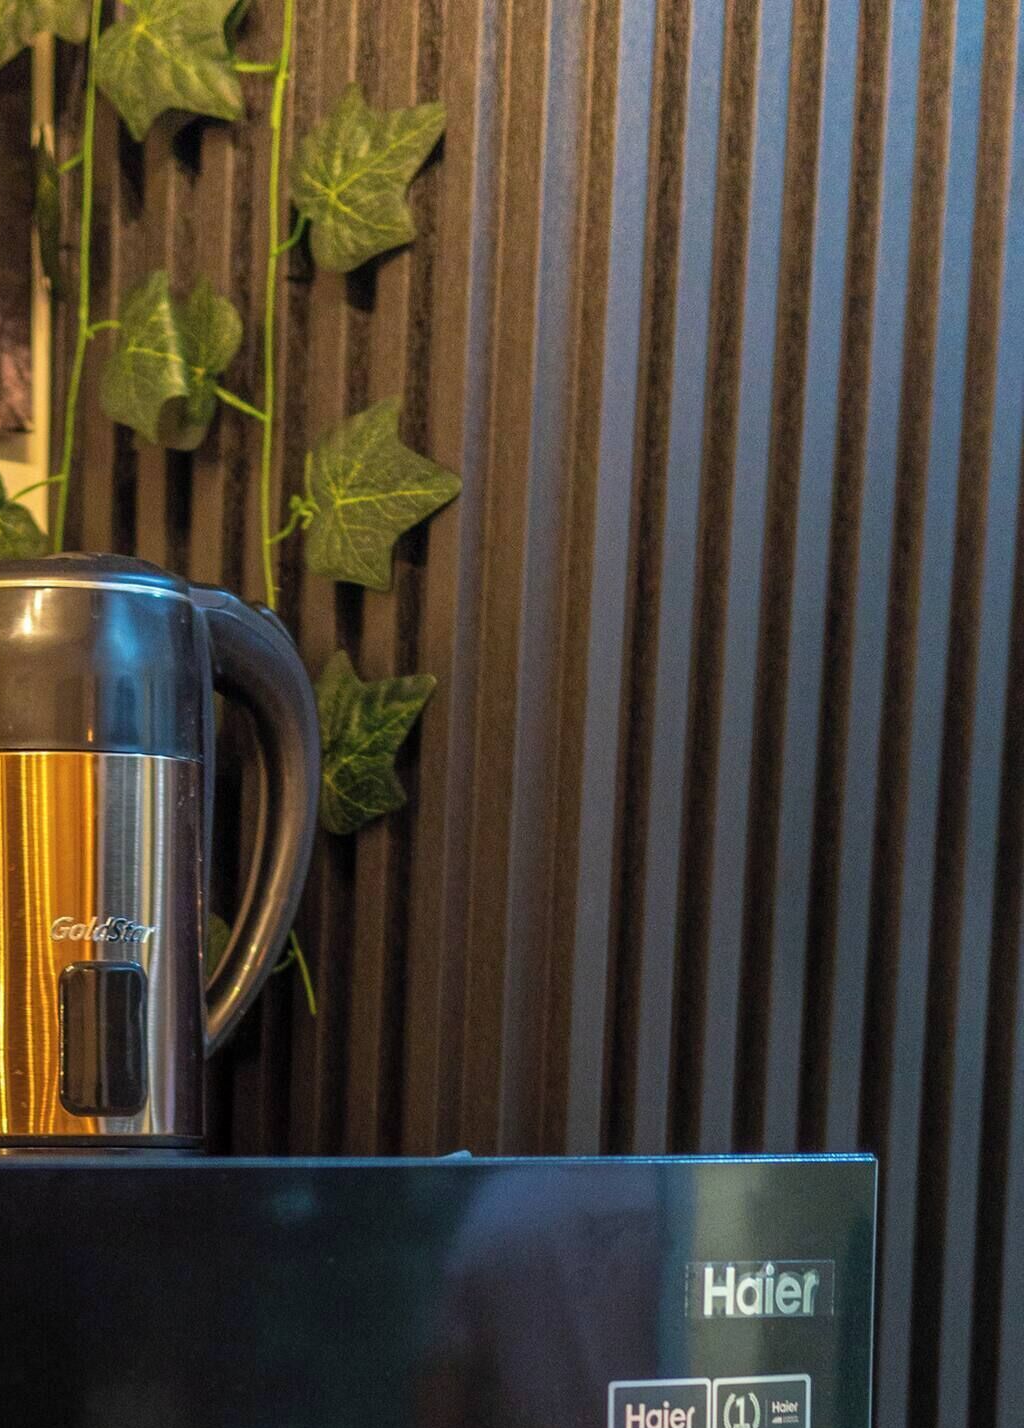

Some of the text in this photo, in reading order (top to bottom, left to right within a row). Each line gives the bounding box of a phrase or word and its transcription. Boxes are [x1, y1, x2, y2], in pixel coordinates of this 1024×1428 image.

[51, 916, 157, 943] GoldStar
[703, 1262, 819, 1316] Haier
[772, 1400, 799, 1415] Haier
